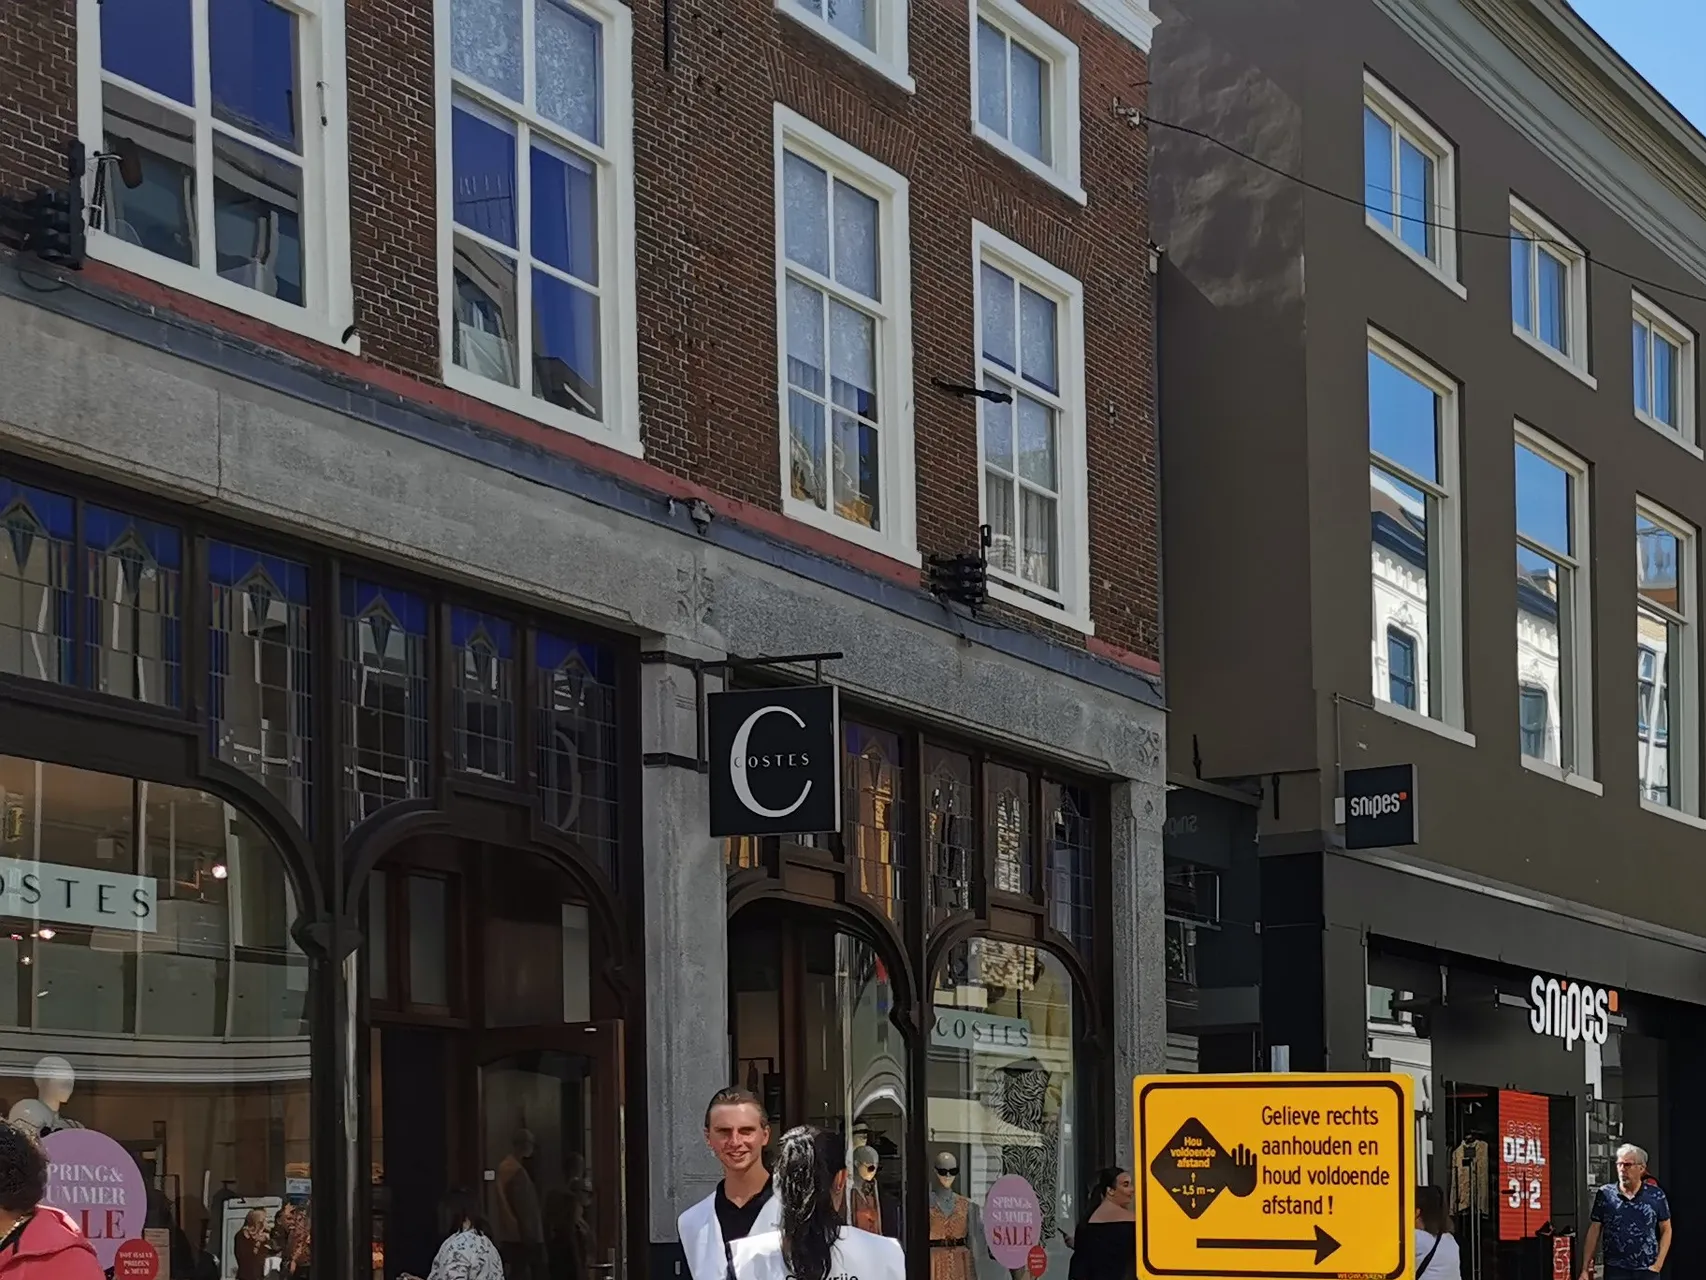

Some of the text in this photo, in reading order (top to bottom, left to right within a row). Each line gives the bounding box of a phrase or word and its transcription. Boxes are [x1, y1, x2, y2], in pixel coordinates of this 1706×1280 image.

[734, 753, 809, 768] COSTES
[1351, 793, 1400, 818] snipes
[1531, 975, 1608, 1051] snipes
[936, 1016, 1029, 1047] COSTES
[1261, 1105, 1379, 1126] Gelieve rechts
[1184, 1136, 1203, 1147] Hou
[1261, 1135, 1379, 1156] aanhouden en
[1503, 1136, 1546, 1165] DEAL
[1170, 1147, 1217, 1158] voldoende
[1177, 1158, 1211, 1169] afstand
[1262, 1165, 1390, 1186] houd voldoende
[45, 1184, 126, 1205] UMMER
[1182, 1184, 1206, 1196] 1,5 m
[1262, 1195, 1334, 1215] afstand !
[992, 1225, 1033, 1247] SALE
